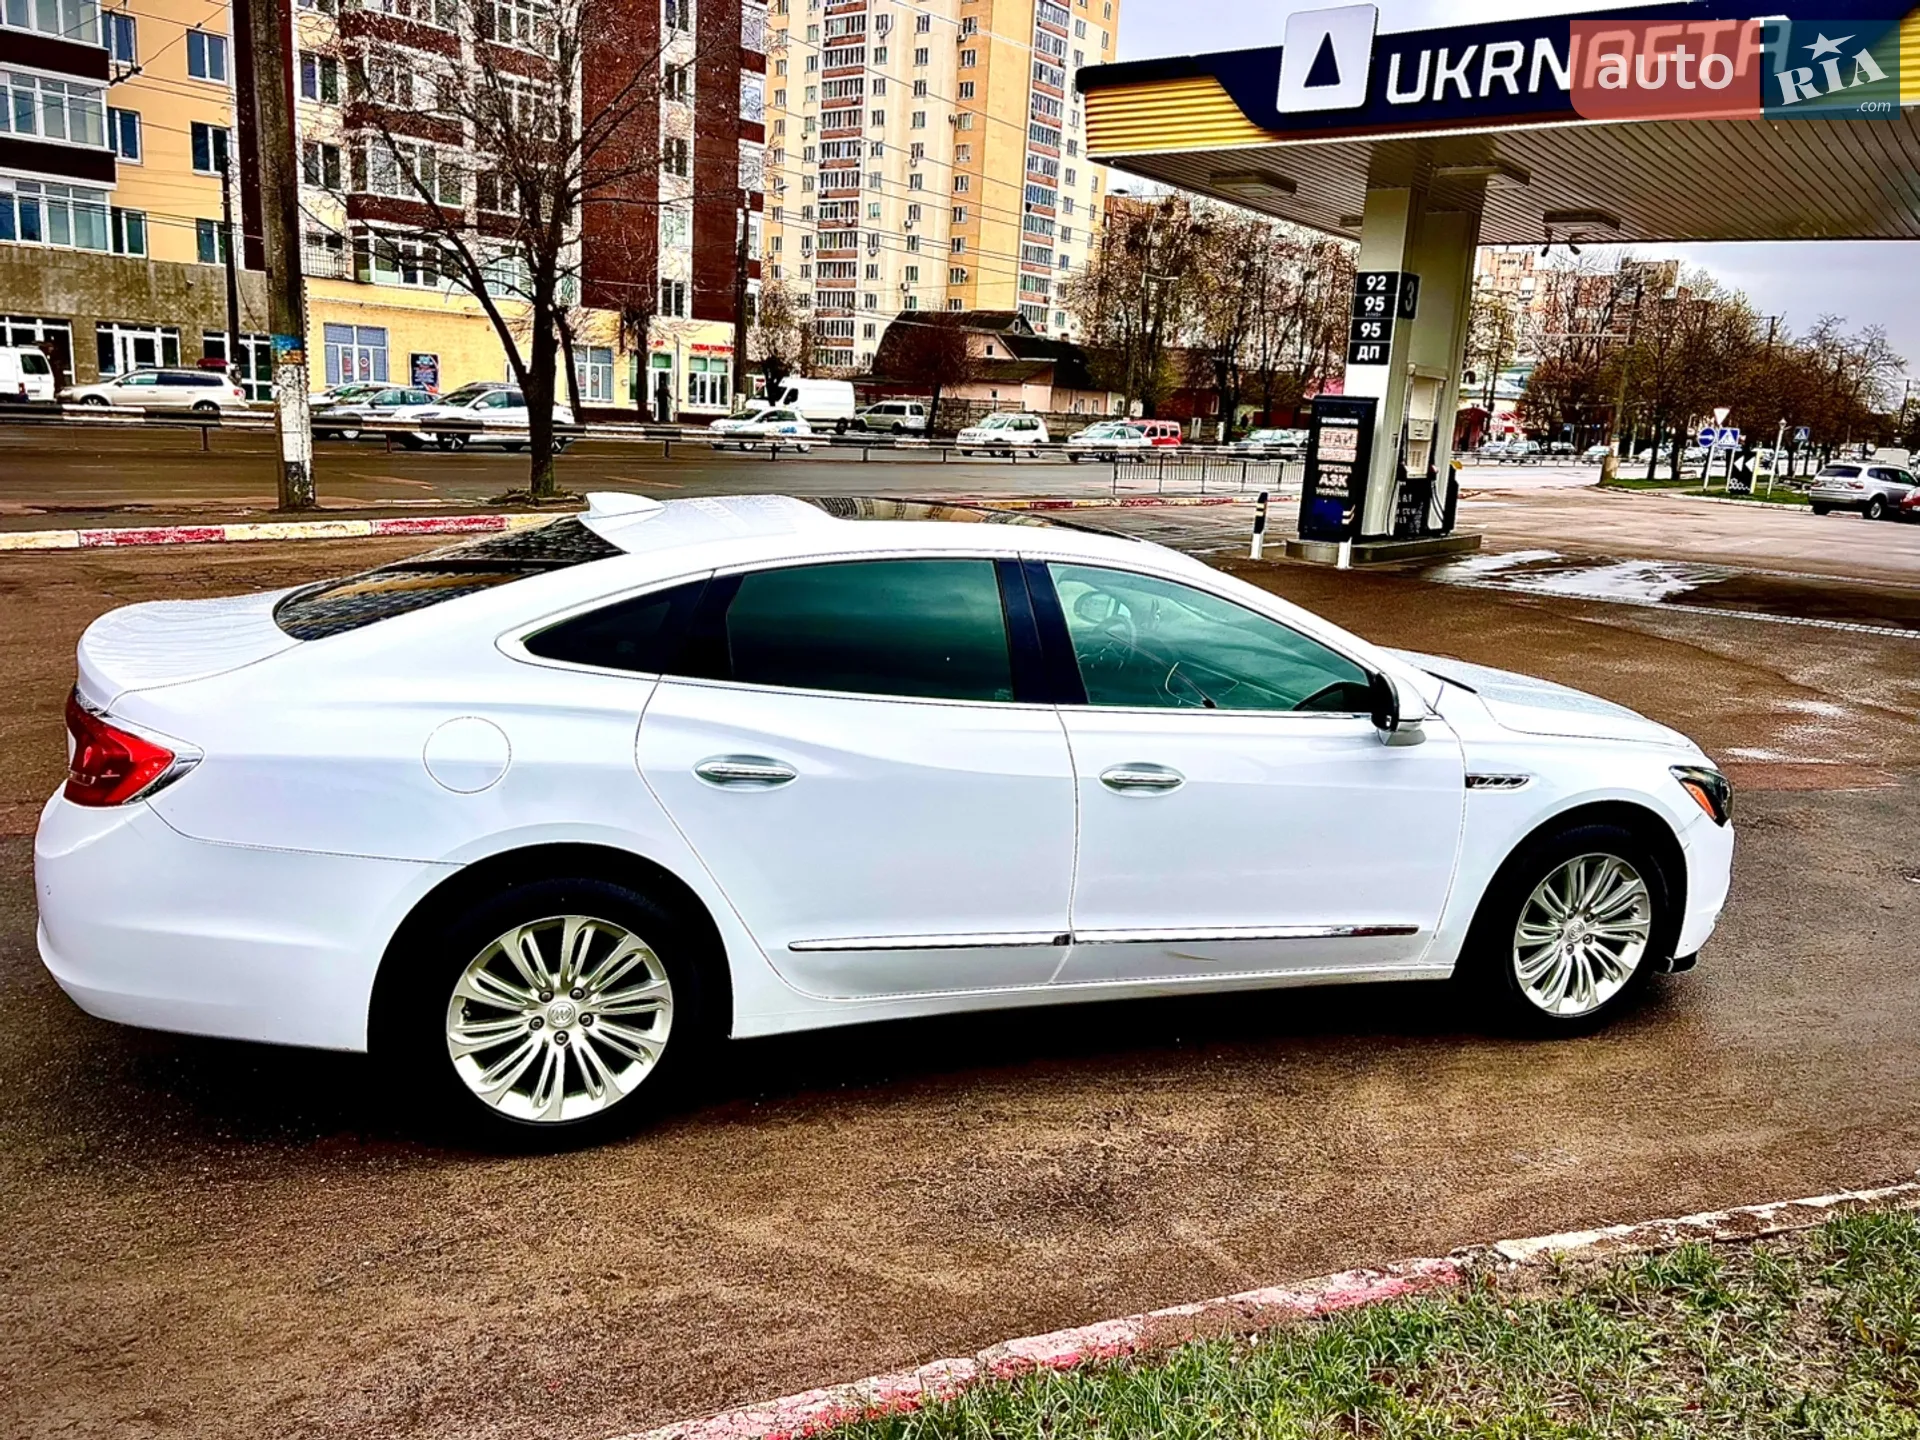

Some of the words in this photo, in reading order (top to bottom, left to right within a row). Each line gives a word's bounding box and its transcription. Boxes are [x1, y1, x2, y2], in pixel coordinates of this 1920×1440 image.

[1387, 15, 1792, 104] UKRNAFTA
[1366, 275, 1387, 291] 92
[1364, 296, 1385, 312] 95
[1405, 281, 1415, 312] 3
[1360, 322, 1381, 338] 95
[1356, 345, 1380, 361] ДП
[1319, 473, 1348, 487] АЗК
